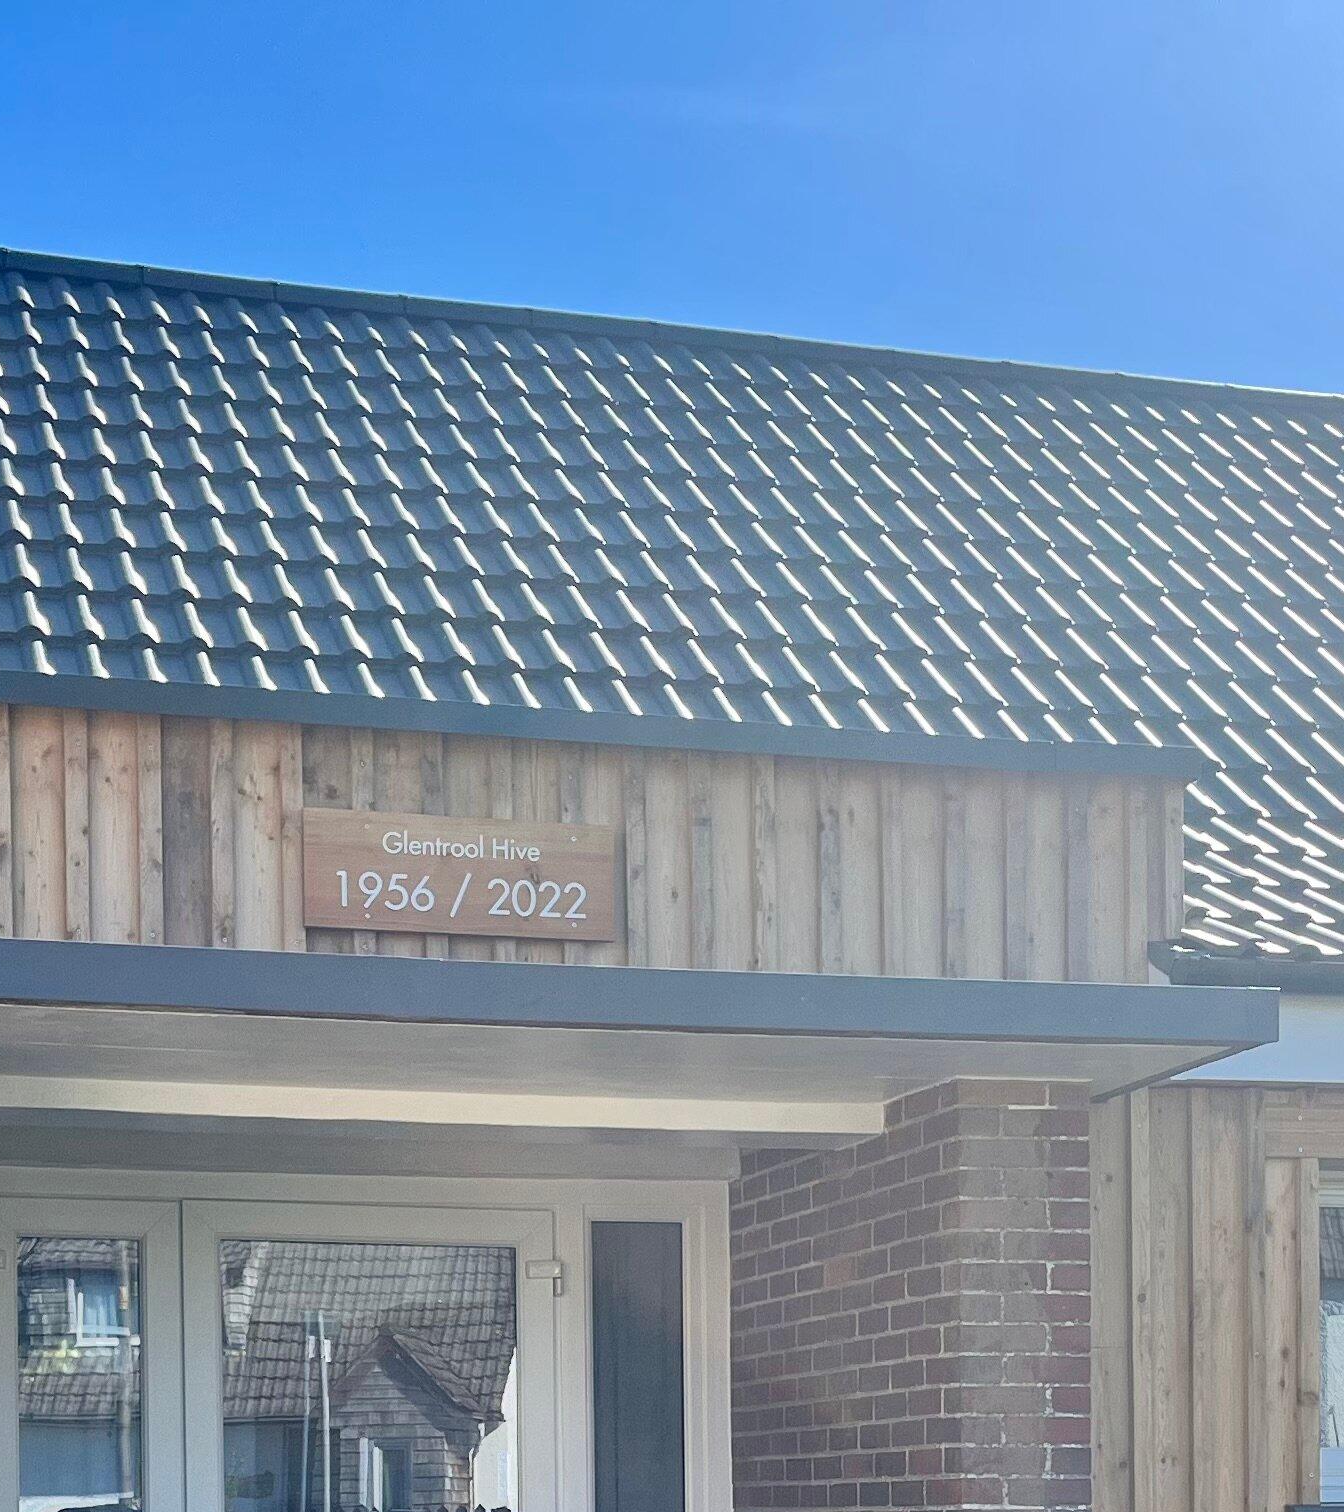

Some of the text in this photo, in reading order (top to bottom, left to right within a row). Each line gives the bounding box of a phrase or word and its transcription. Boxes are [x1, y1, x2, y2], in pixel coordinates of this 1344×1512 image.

[382, 830, 541, 862] Glentrool Hive
[335, 870, 587, 919] 1956 / 2022
